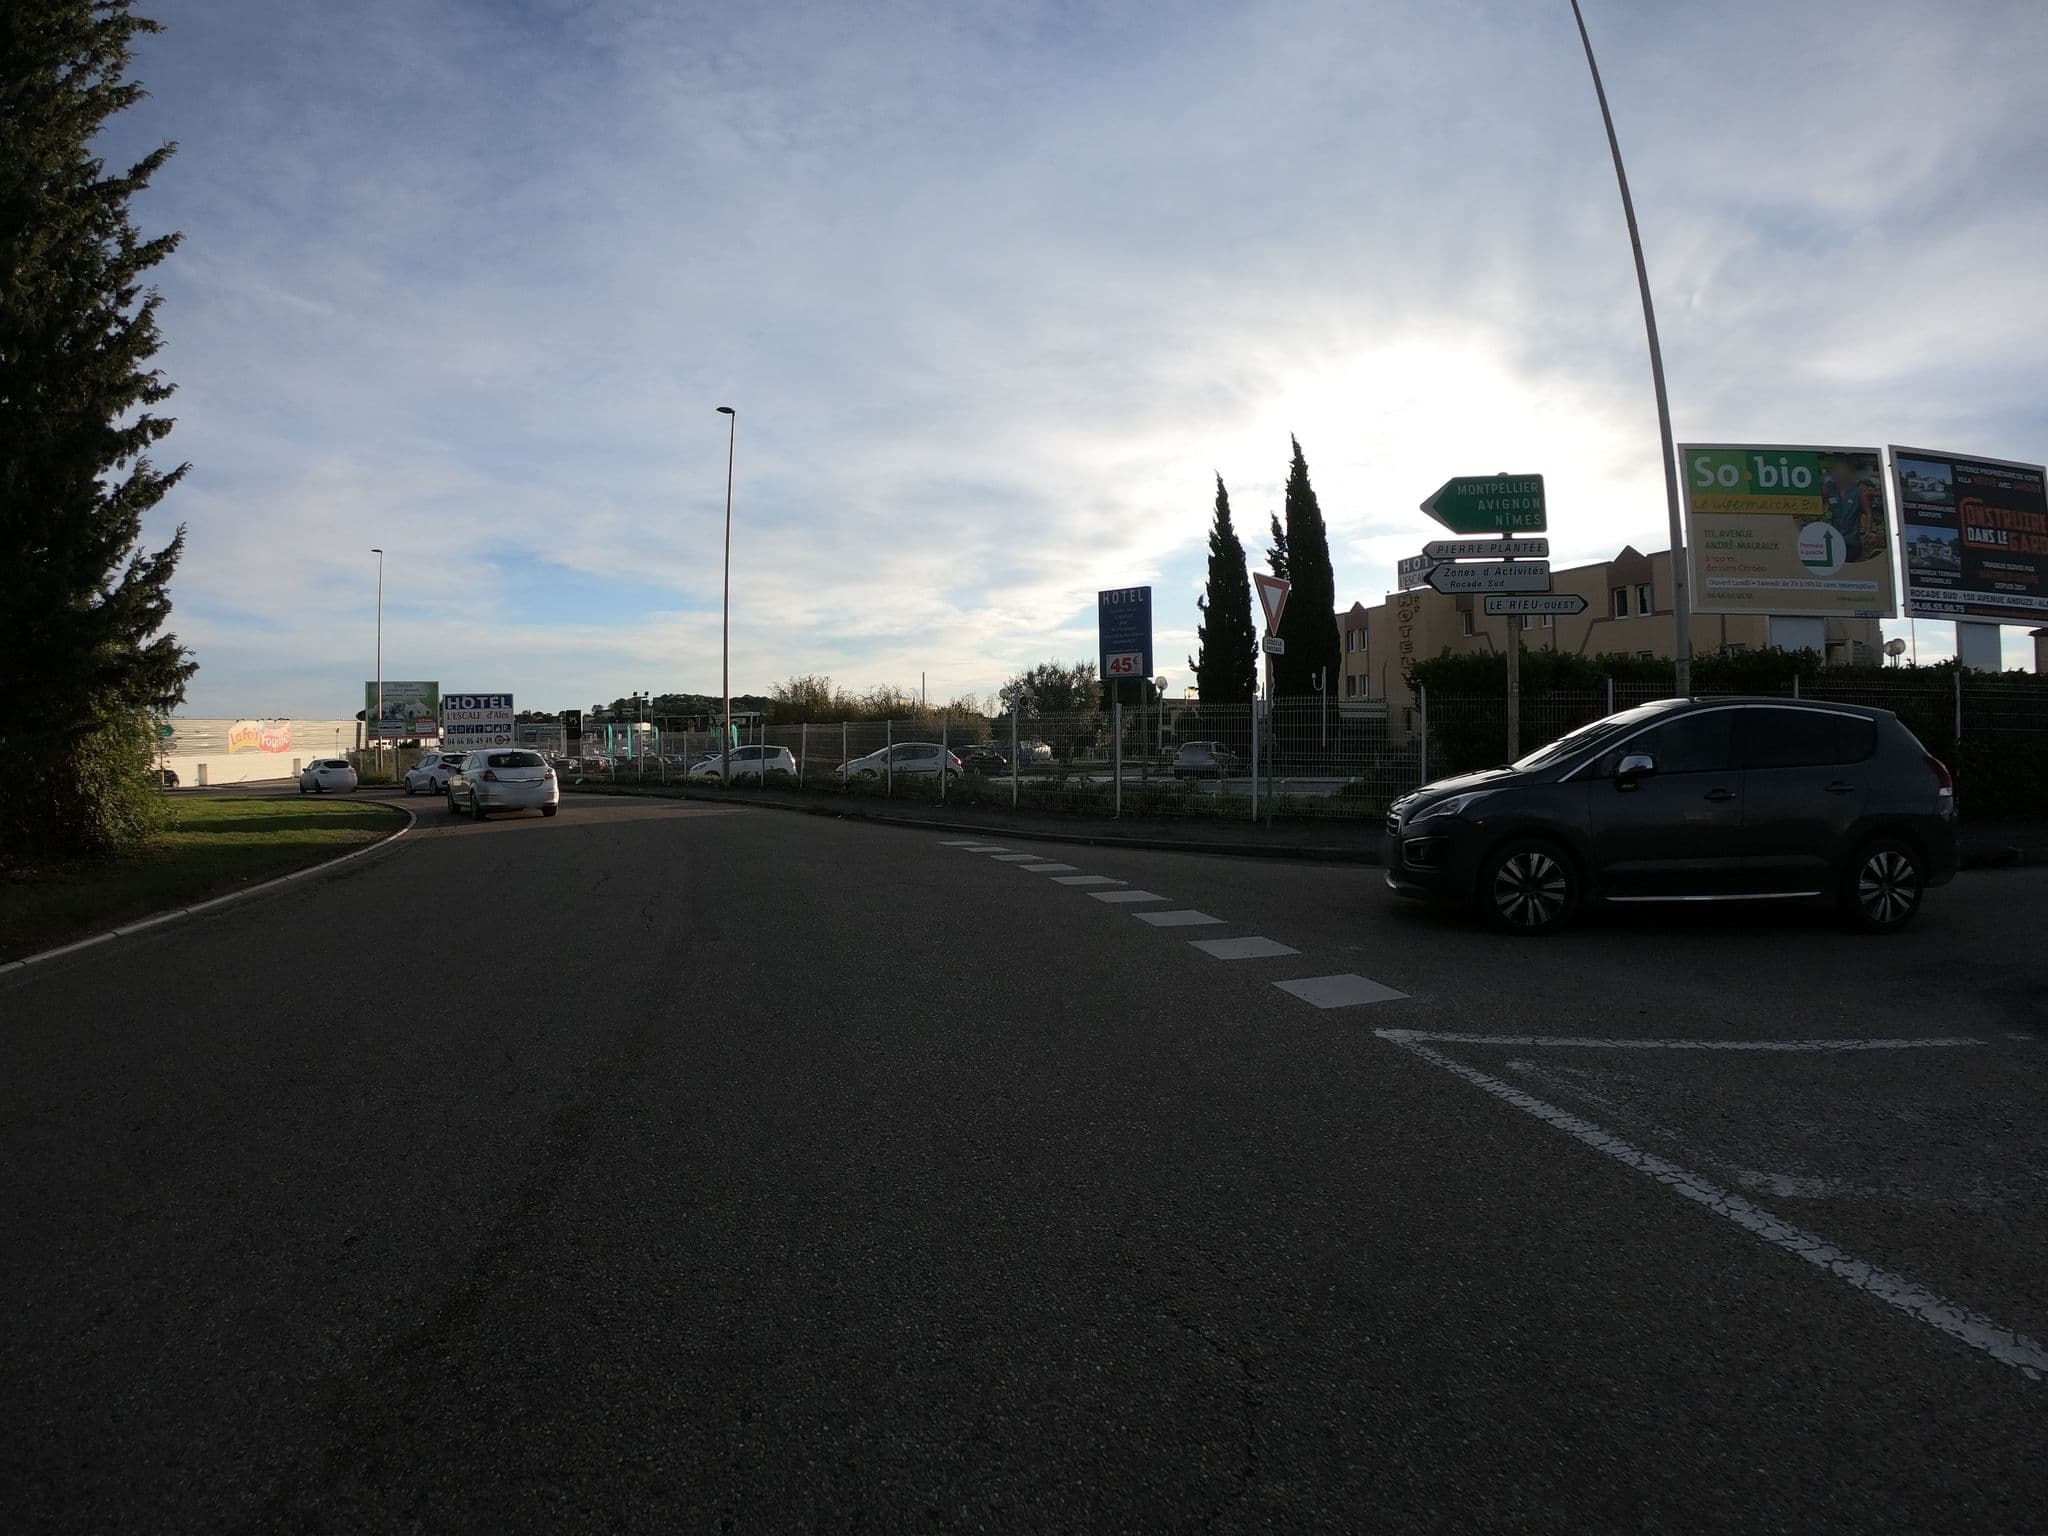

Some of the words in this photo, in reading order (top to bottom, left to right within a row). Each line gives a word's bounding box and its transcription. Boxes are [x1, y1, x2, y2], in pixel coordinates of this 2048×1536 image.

[1694, 456, 1739, 487] So
[1754, 455, 1811, 488] bio
[1457, 481, 1538, 496] MONTPELLIER
[1478, 497, 1540, 511] AVIGNON
[1719, 529, 1753, 538] AVENUE
[1967, 527, 1995, 543] DANS
[1997, 530, 2009, 545] LE
[1437, 543, 1483, 555] PIERRE
[1444, 567, 1476, 577] Zones
[1488, 579, 1504, 588] Sud
[1103, 589, 1144, 606] HOTEL
[1910, 588, 1940, 599] ROCADE
[1943, 590, 1958, 600] SUD
[1977, 594, 2006, 604] AVENUE
[1490, 601, 1502, 610] LE
